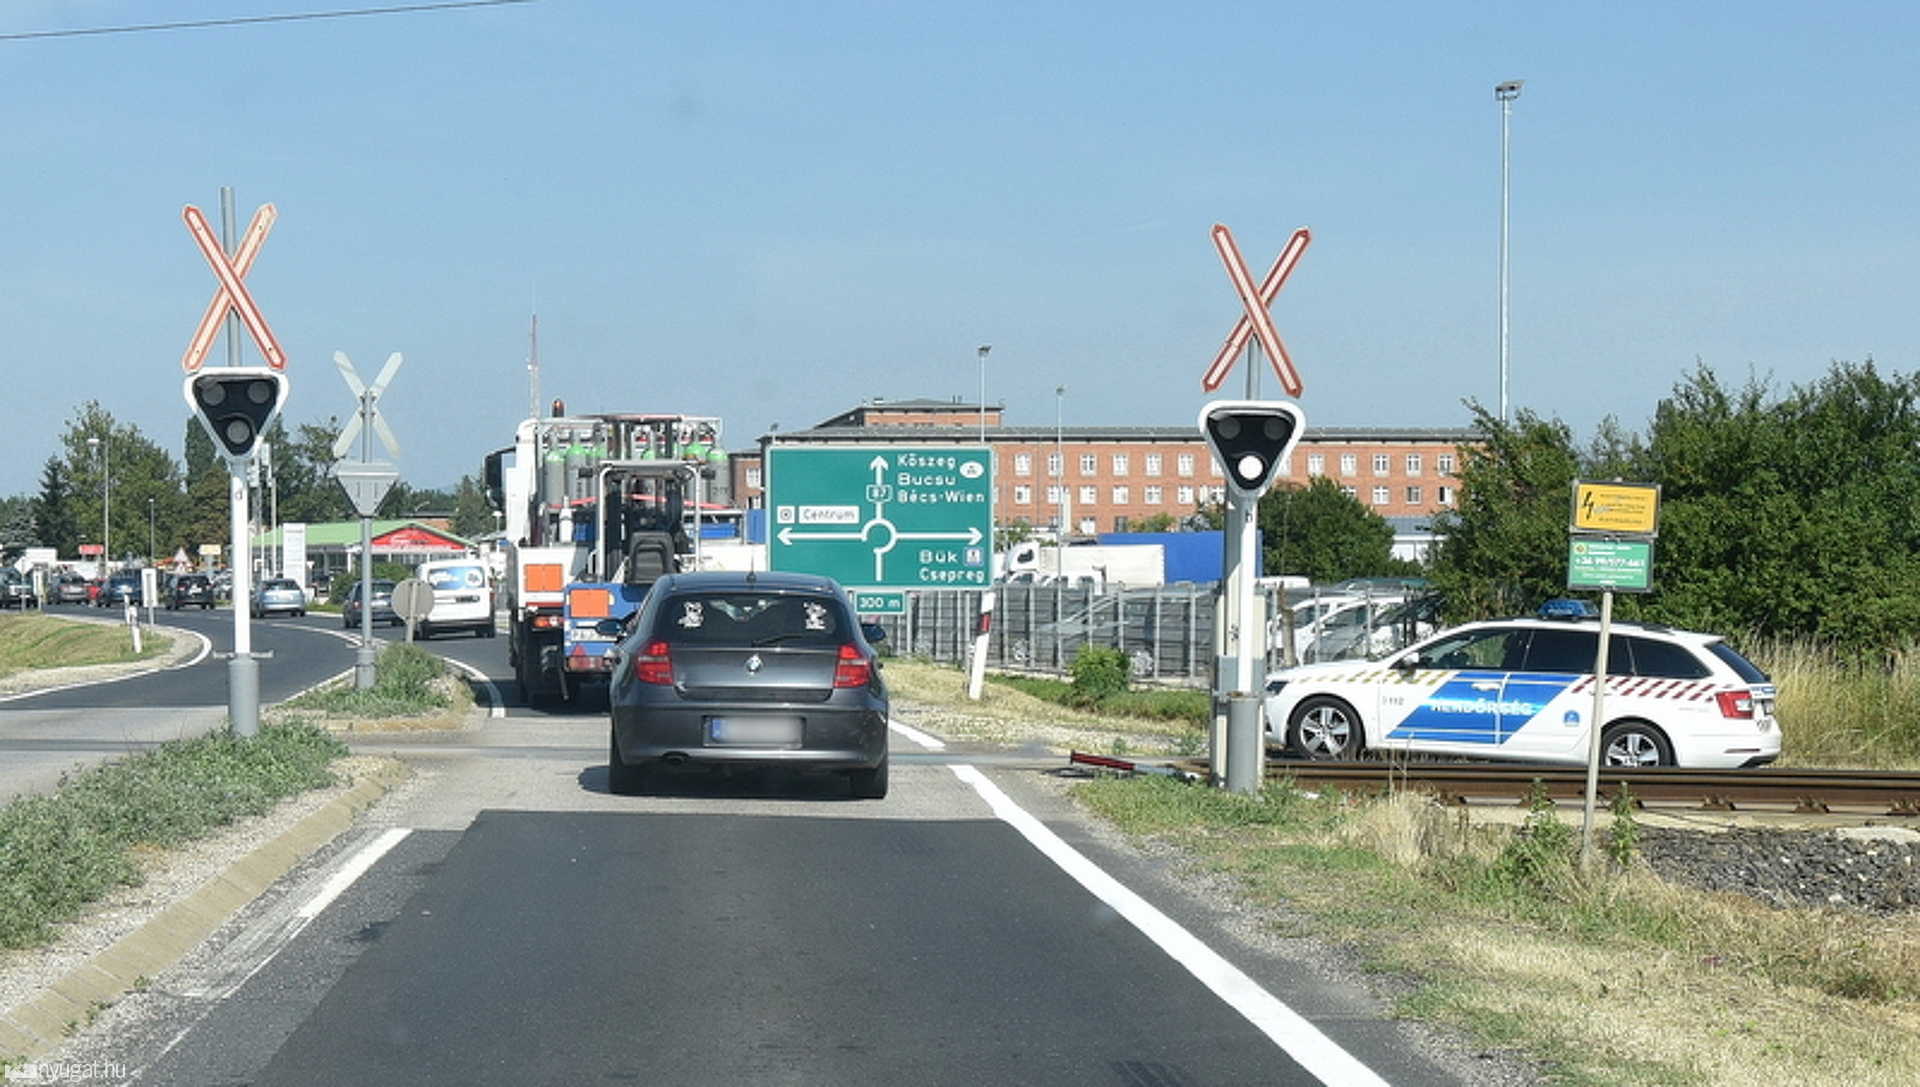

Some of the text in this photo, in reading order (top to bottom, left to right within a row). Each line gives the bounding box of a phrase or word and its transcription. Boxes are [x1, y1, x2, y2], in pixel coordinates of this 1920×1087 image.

[896, 471, 957, 486] Bucsu
[896, 489, 986, 503] Bécs-Wien
[802, 509, 856, 521] Centrum
[919, 549, 958, 563] Bük
[918, 567, 986, 583] Csepreg
[858, 596, 901, 608] 300 m
